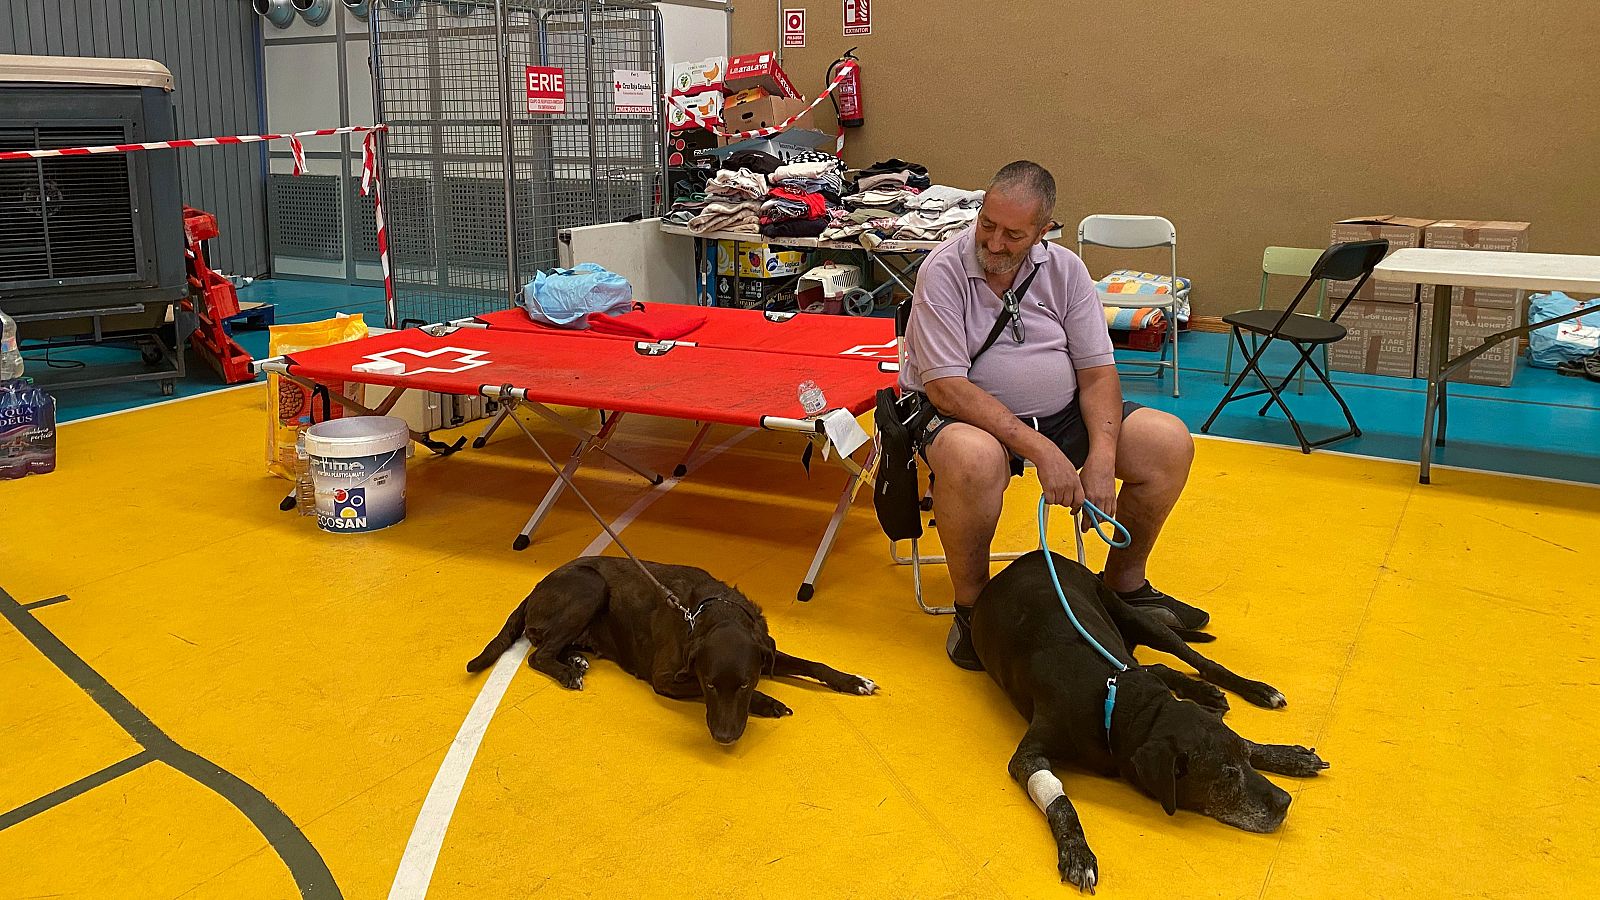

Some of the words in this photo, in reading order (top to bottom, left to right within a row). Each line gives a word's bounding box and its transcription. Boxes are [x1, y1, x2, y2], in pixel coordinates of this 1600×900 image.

[528, 72, 564, 93] ERIE
[1387, 338, 1405, 346] ARE
[1380, 345, 1404, 353] LUED
